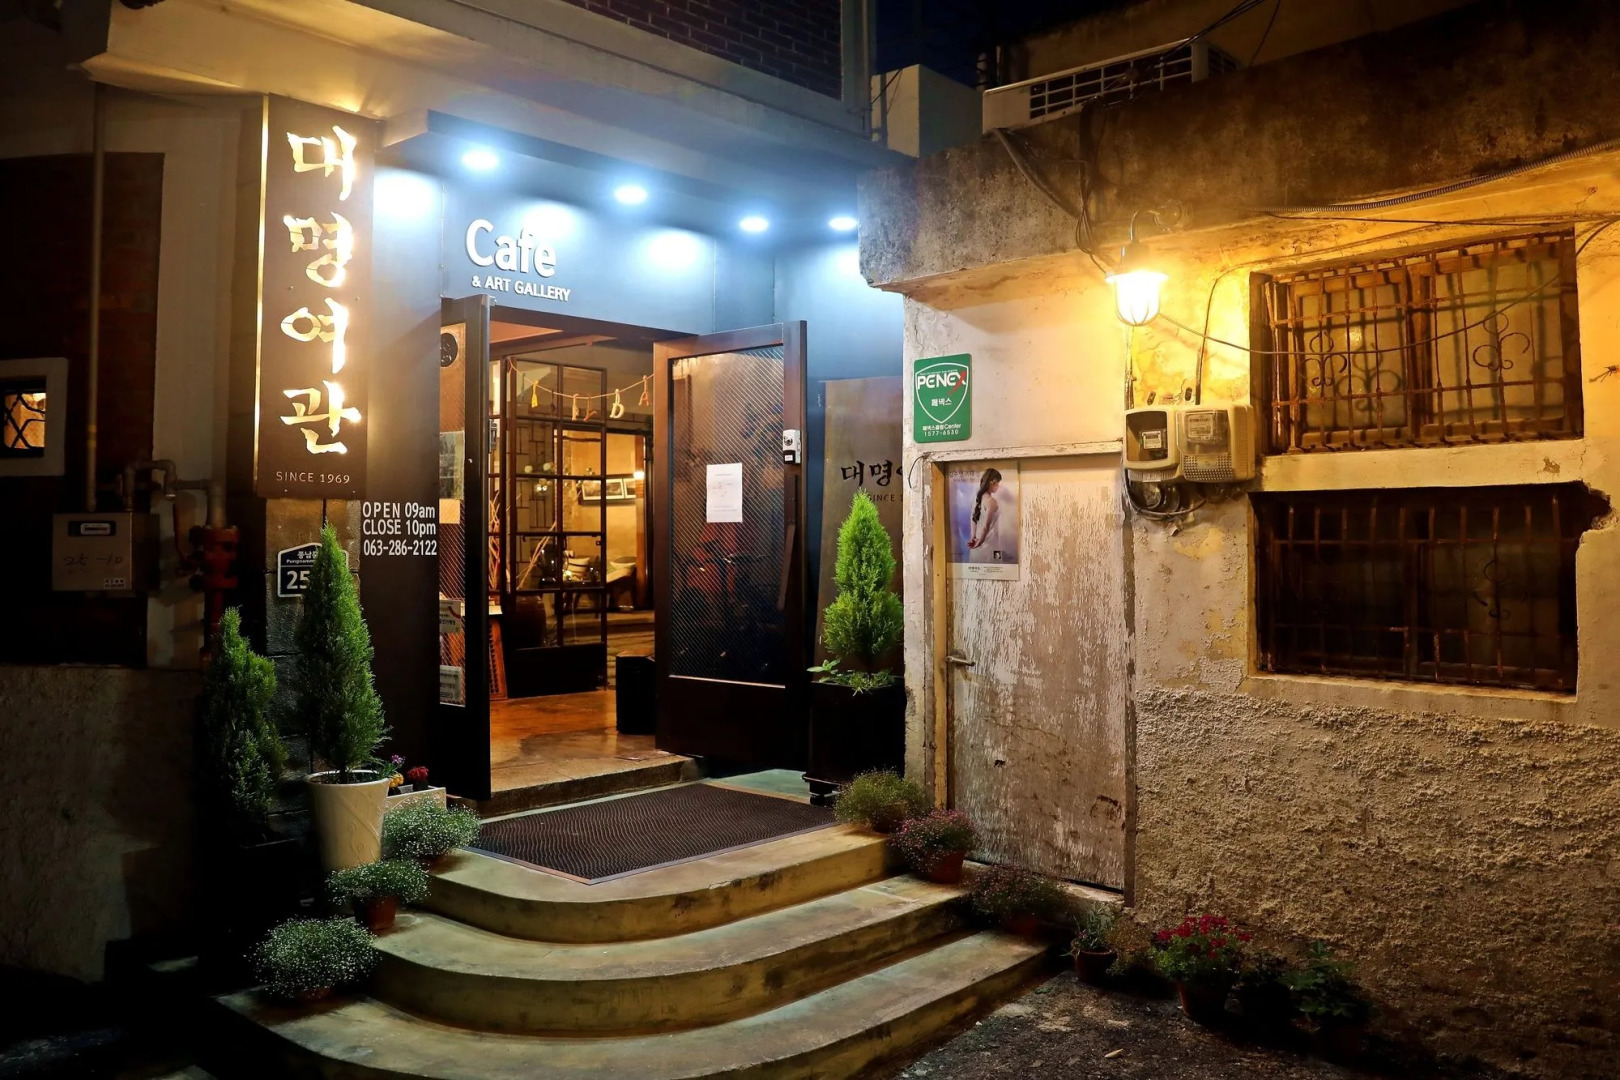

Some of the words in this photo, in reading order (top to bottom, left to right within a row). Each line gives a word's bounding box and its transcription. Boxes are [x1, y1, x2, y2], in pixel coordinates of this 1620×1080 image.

[465, 218, 557, 278] Cafe
[280, 125, 362, 454] 대명여관
[471, 275, 482, 288] &
[485, 275, 511, 292] ART
[514, 280, 571, 301] GALLERY
[917, 371, 967, 394] PENEX
[276, 471, 314, 483] SINCE
[320, 473, 350, 484] 1969
[362, 502, 400, 518] OPEN
[405, 502, 435, 518] 09am
[362, 519, 401, 535] CLOSE
[405, 520, 437, 538] 10pm
[363, 539, 437, 556] 063-286-2122
